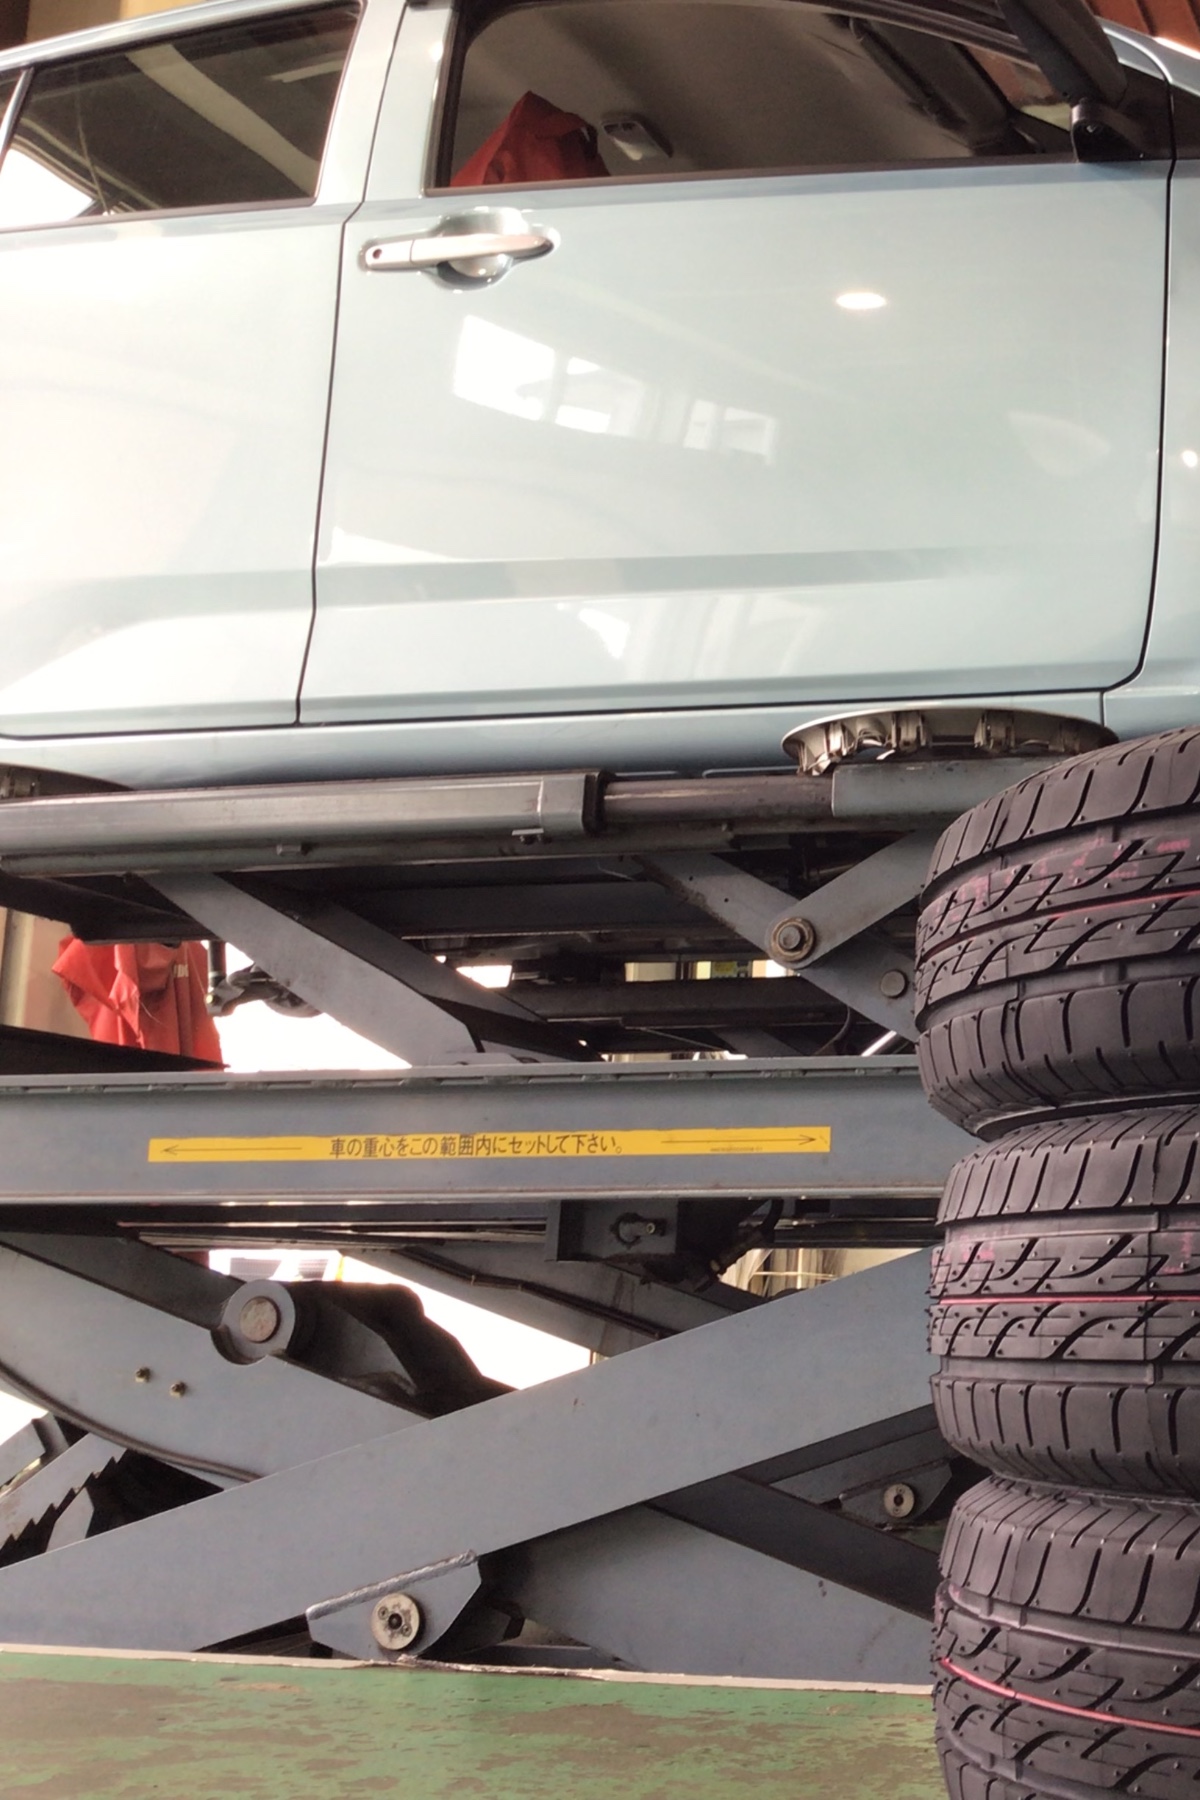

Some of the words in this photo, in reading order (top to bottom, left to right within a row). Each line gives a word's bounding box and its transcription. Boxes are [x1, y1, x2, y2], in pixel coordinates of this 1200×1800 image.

[330, 1133, 623, 1159] 車の重心をこの範囲内にセットして下さい。
